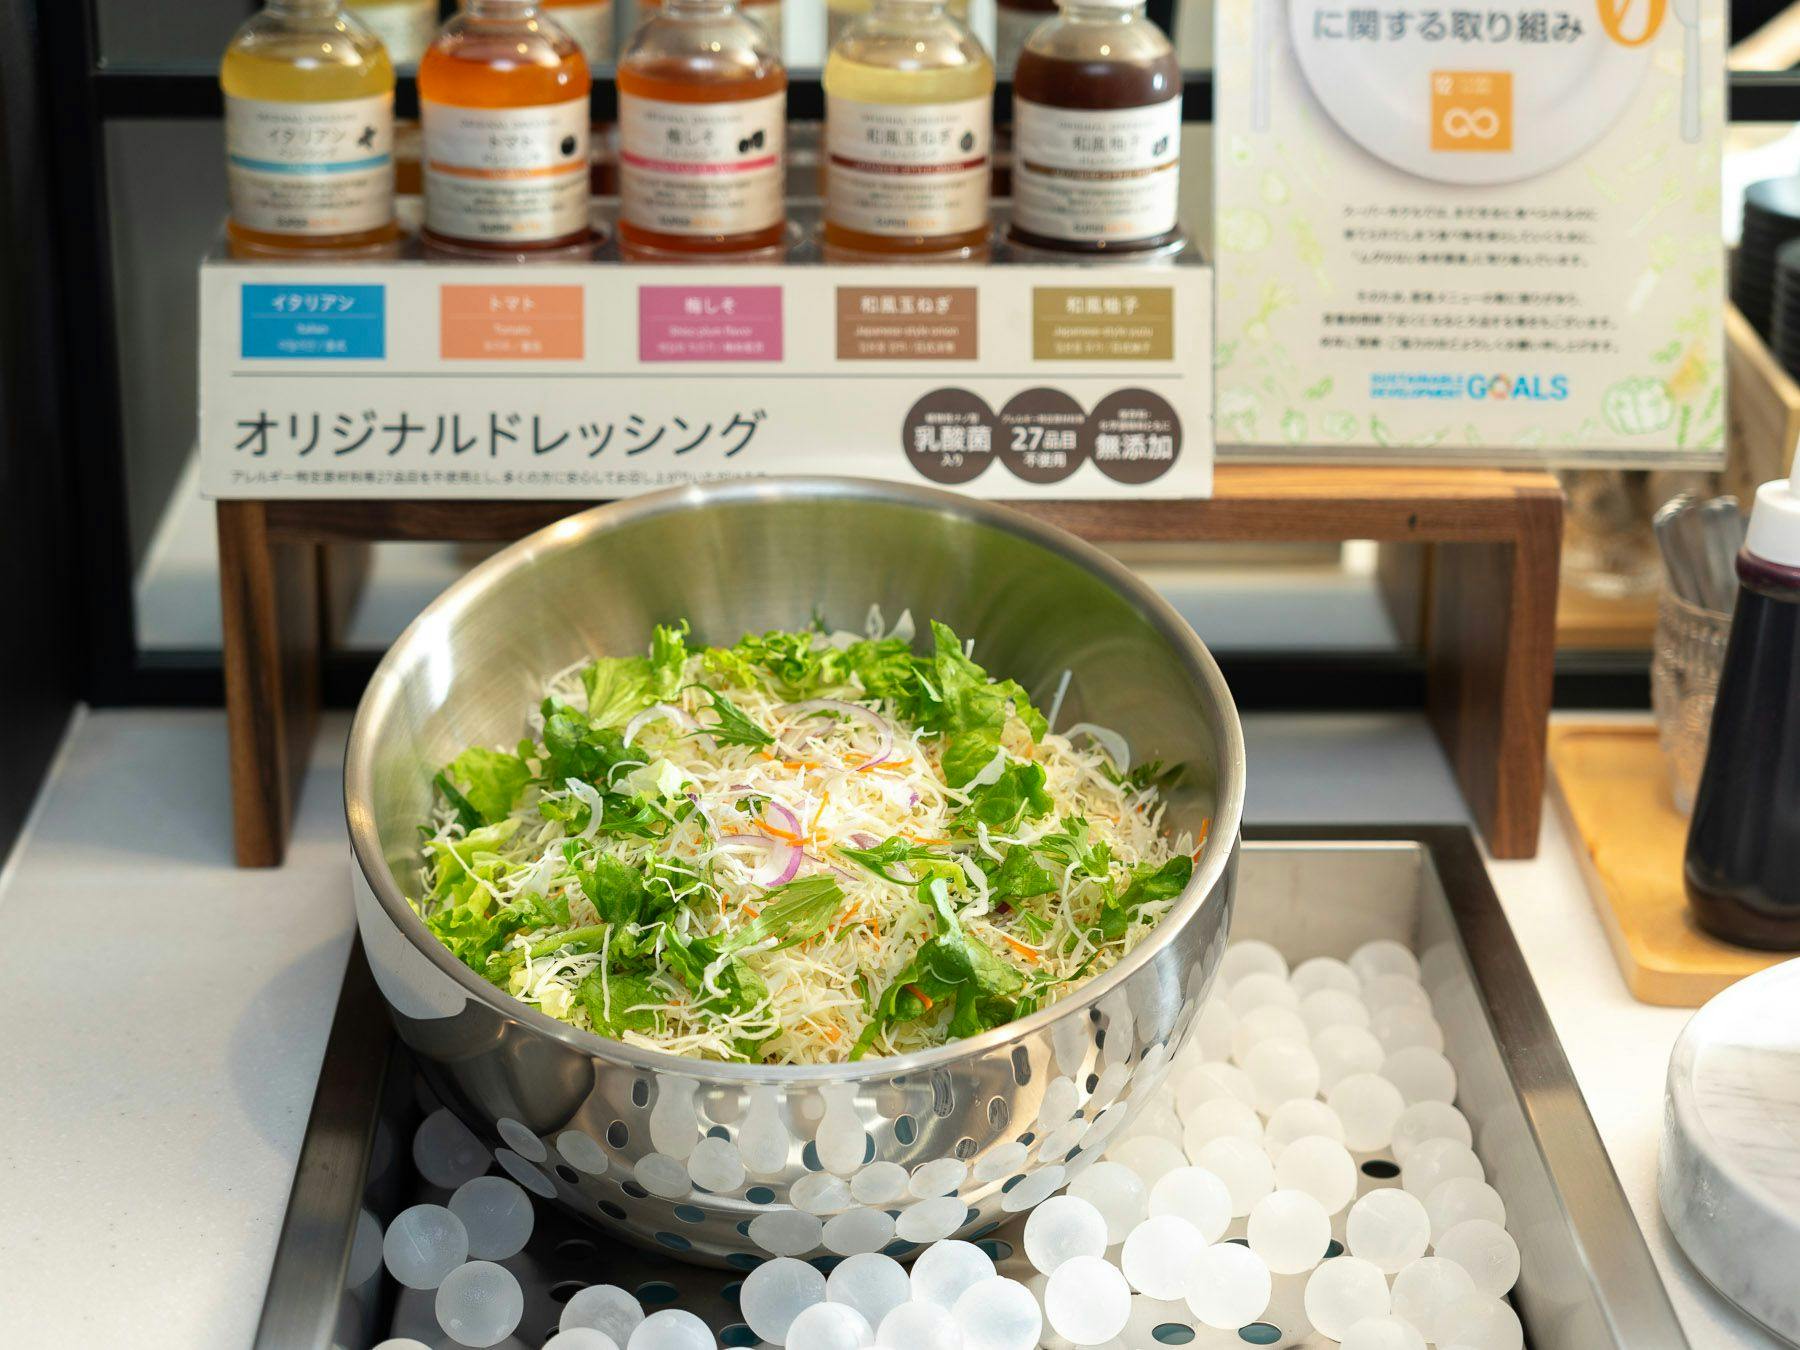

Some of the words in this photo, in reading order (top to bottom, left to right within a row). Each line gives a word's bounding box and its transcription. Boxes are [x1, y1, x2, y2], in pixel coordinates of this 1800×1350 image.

[1313, 9, 1583, 44] に関する取り組み
[271, 293, 355, 312] イタリアン
[489, 295, 536, 312] トマト
[683, 296, 736, 315] 梅しそ
[860, 295, 953, 314] 和風玉ねぎ
[1467, 373, 1568, 400] GOALS
[235, 409, 767, 457] オリジナルドレッシング
[914, 426, 992, 451] 乳酸菌
[1011, 427, 1077, 450] 27品目
[1096, 434, 1174, 460] 無添加
